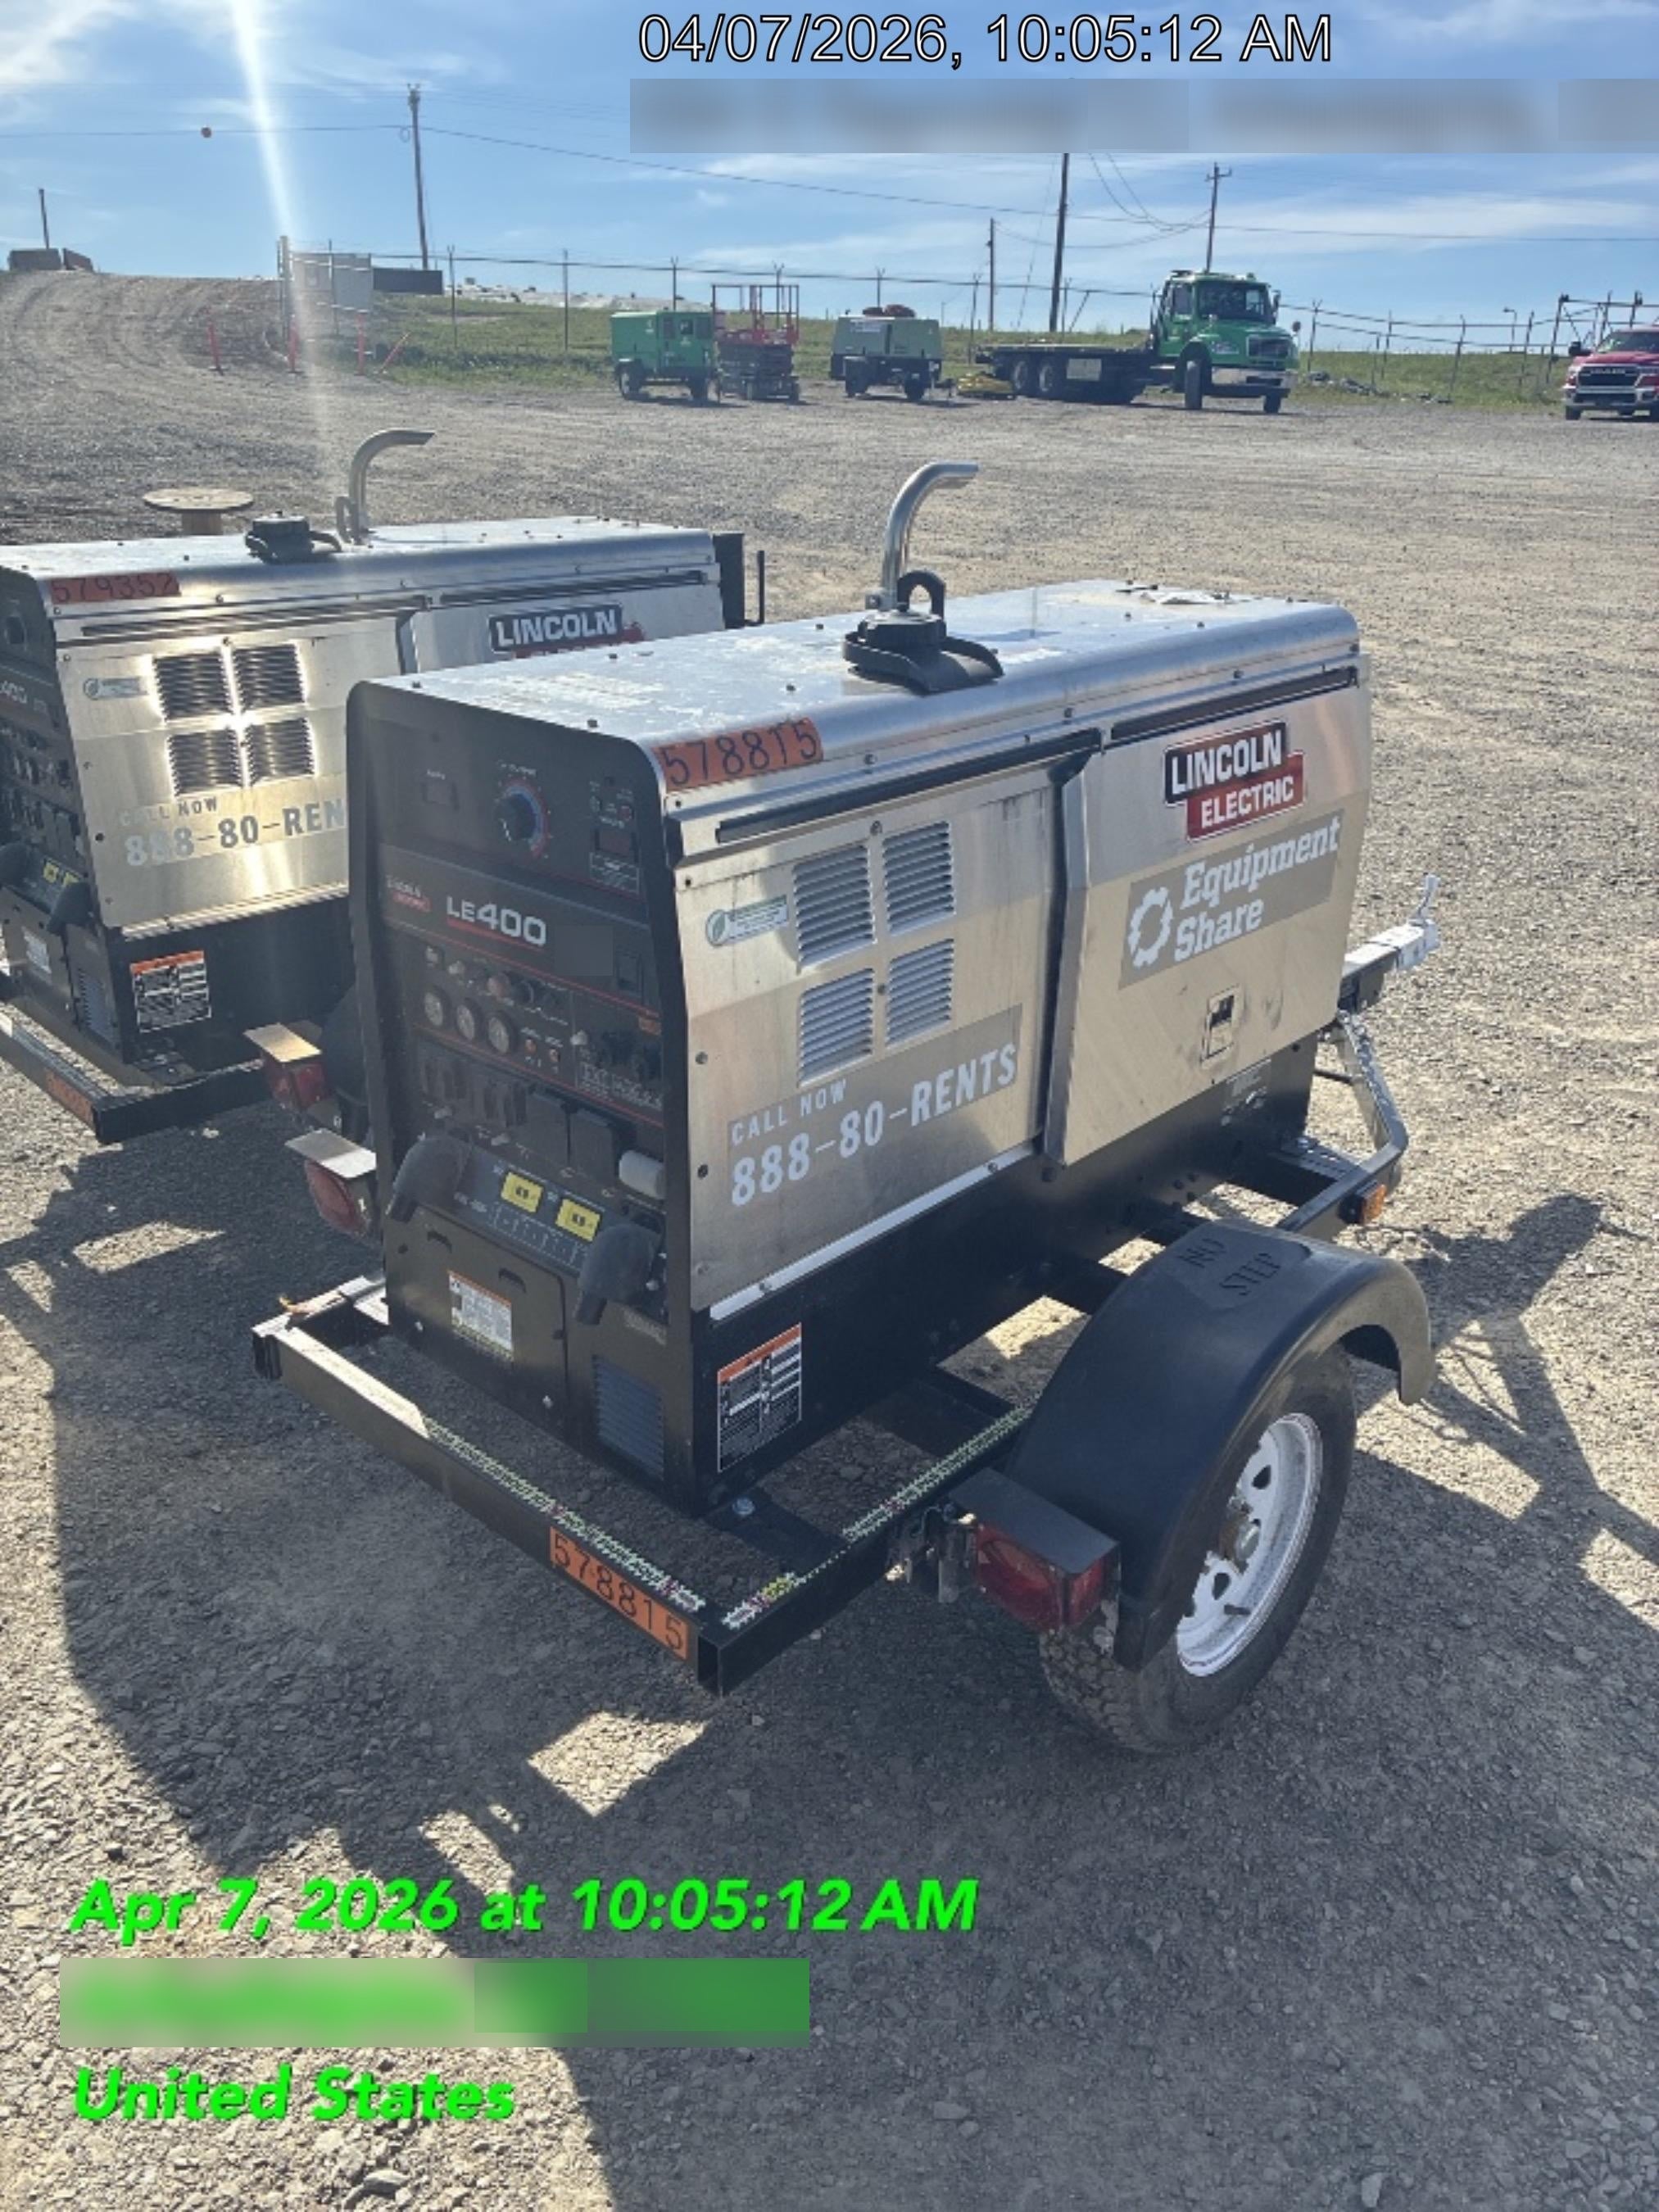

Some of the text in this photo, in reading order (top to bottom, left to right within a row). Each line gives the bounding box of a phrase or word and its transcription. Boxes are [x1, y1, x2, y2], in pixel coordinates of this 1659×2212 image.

[496, 609, 618, 647] LINCOLN
[1172, 729, 1281, 796] LINCOLN
[179, 796, 217, 817] NOW
[1201, 775, 1294, 829] ELECTRIC
[1181, 815, 1341, 909] Equipment
[446, 895, 546, 946] LE400
[1174, 899, 1264, 962] Share
[732, 1078, 847, 1146] CALL NOW
[732, 1042, 1017, 1207] 888-80-RENTS
